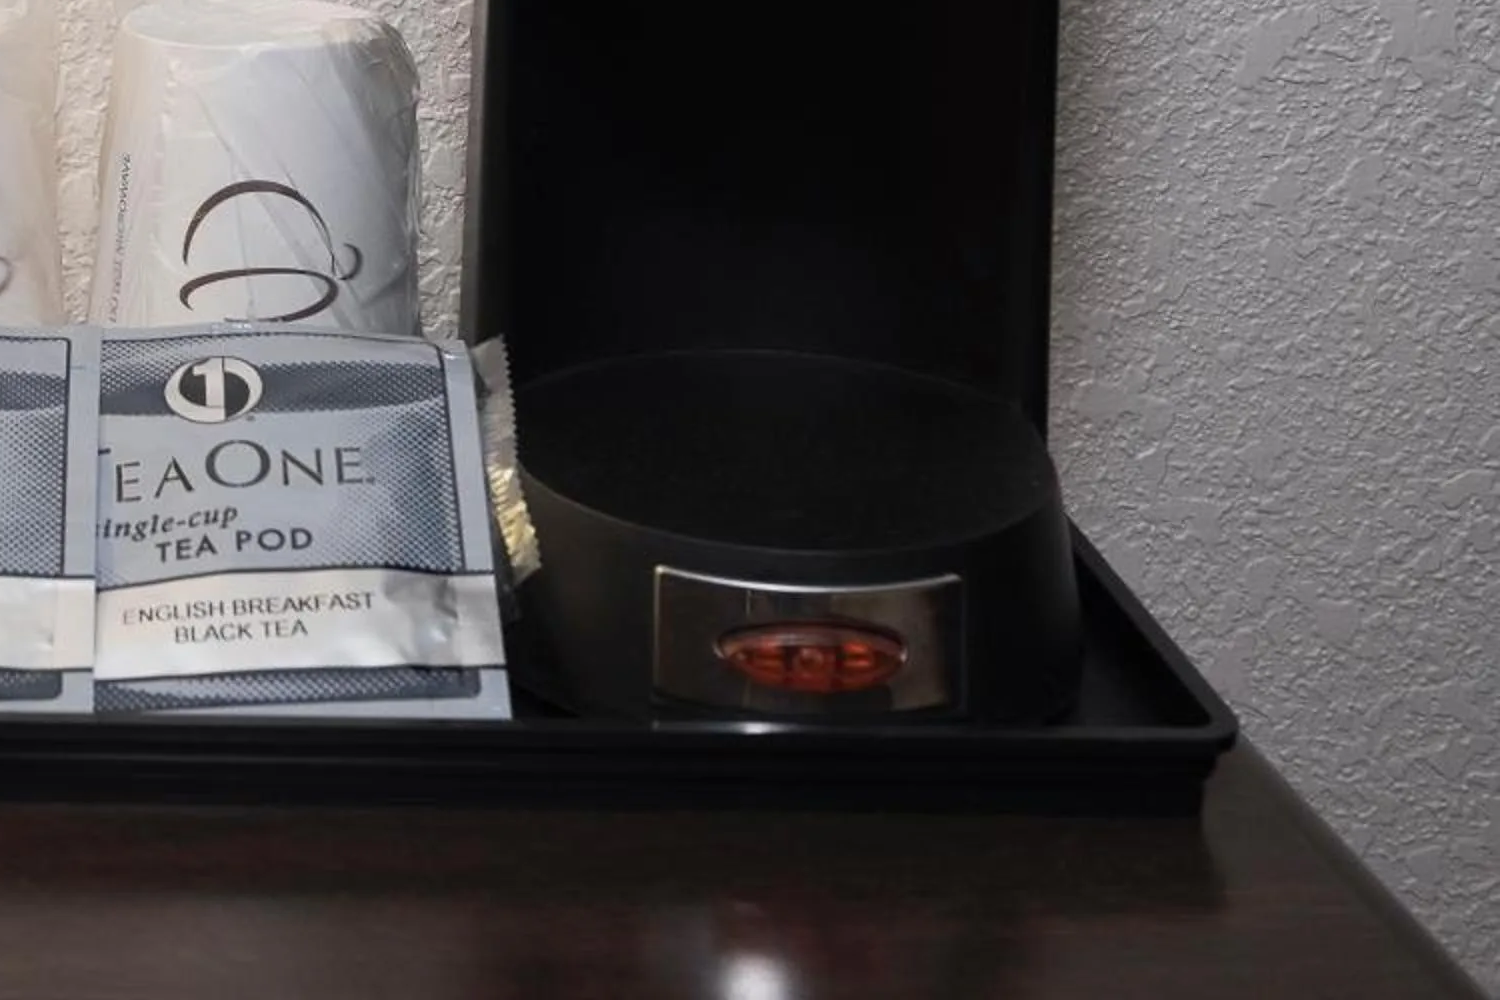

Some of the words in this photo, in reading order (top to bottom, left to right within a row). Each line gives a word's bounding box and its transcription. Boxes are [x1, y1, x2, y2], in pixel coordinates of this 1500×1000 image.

[98, 439, 362, 502] EAONE
[156, 533, 218, 563] TEA
[235, 528, 313, 551] POD
[122, 601, 225, 625] ENGLISH
[233, 592, 375, 616] BREAKFAST
[174, 622, 252, 644] BLACK
[261, 618, 309, 639] TEA
